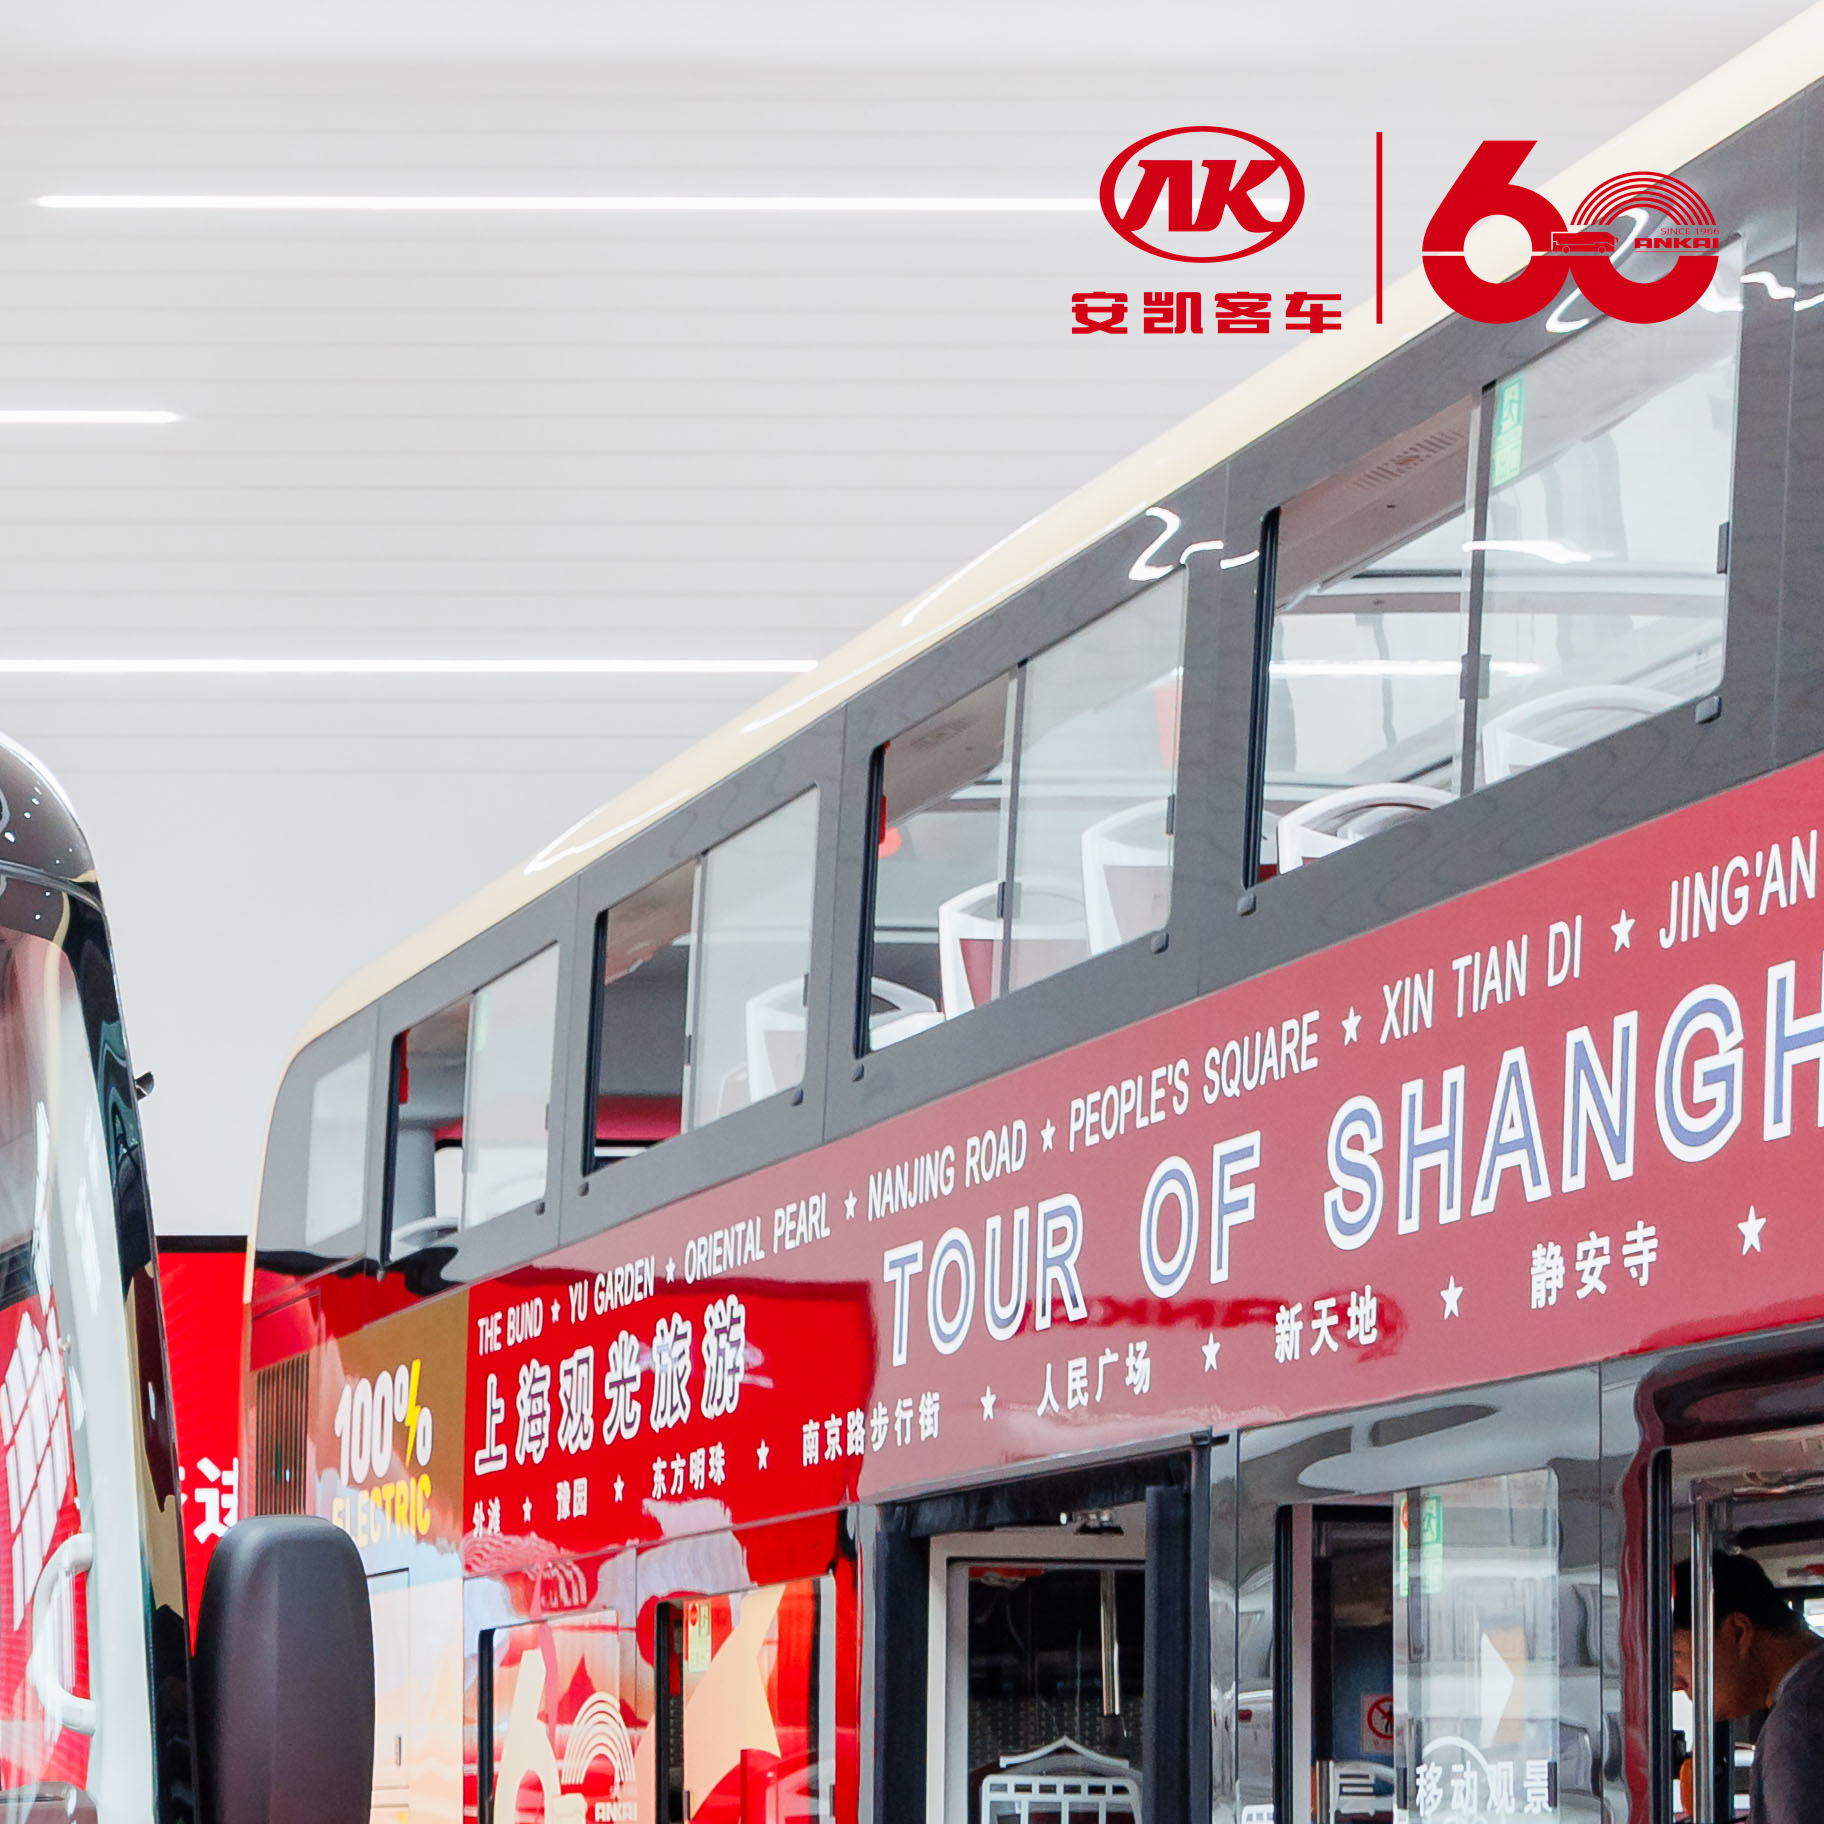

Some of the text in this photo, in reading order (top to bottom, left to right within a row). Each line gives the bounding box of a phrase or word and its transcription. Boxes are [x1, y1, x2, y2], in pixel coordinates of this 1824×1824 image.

[477, 829, 1817, 1356] THE BUND YU GARDEN ORIENTAL PEARL NANJING ROAD PEOPLE'S SQUARE XIN TIAN DI JING'AN
[882, 950, 1824, 1368] TOUR OF SHANGH
[334, 1358, 433, 1487] 100%
[474, 1293, 747, 1478] 上海观光旅游
[652, 1440, 726, 1500] 东方明珠
[801, 1391, 941, 1467] 南京路步行街
[1037, 1340, 1151, 1418] 人民广场
[1275, 1284, 1378, 1364] 新天地
[1530, 1219, 1658, 1310] 静安寺
[1416, 1759, 1553, 1816] 移动观景
